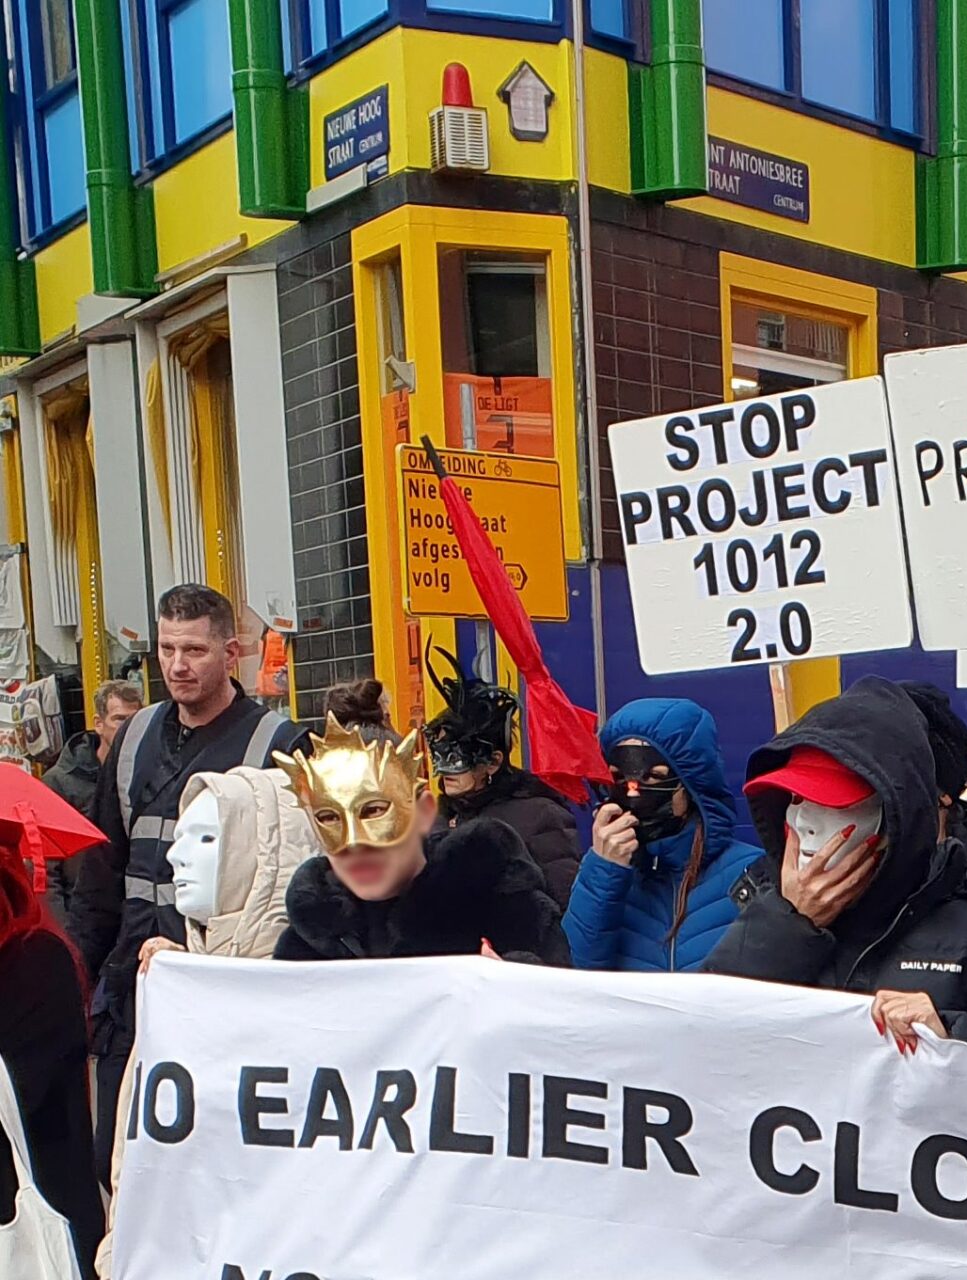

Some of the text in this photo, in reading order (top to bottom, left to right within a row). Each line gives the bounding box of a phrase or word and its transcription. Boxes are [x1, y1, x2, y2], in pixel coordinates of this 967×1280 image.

[327, 95, 381, 141] NIEUWE HOOG
[328, 138, 354, 168] STRAAT
[710, 143, 803, 188] NT ANTONIESBREE
[708, 168, 741, 195] TRAAT
[666, 393, 816, 471] STOP
[408, 452, 486, 475] OMEIDING
[409, 478, 472, 501] Niee
[620, 449, 887, 545] PROJECT
[410, 508, 507, 535] Hoogaat
[412, 568, 450, 593] volg
[694, 529, 825, 596] 1012
[727, 601, 812, 663] 2.0
[900, 961, 963, 973] DAILY PAPER
[127, 1060, 195, 1144] O
[238, 1066, 700, 1177] EARLIER
